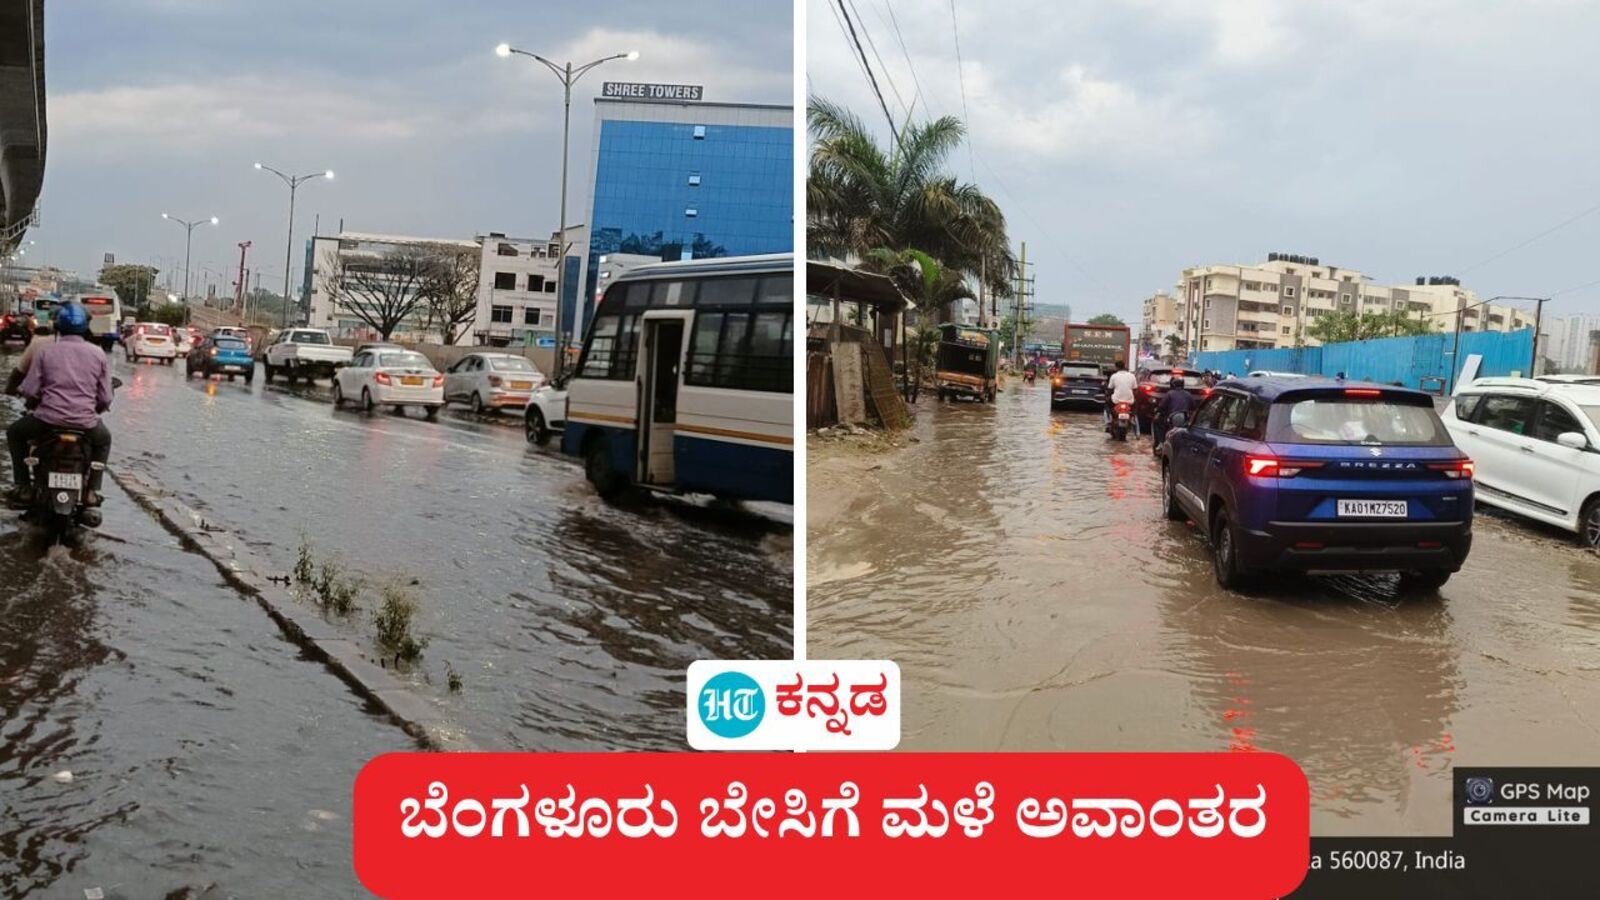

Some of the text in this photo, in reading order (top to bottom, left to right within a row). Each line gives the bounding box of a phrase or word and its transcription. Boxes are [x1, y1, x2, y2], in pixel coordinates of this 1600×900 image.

[606, 83, 699, 98] SHREE TOWERS
[1344, 502, 1406, 515] KA01MZ7520
